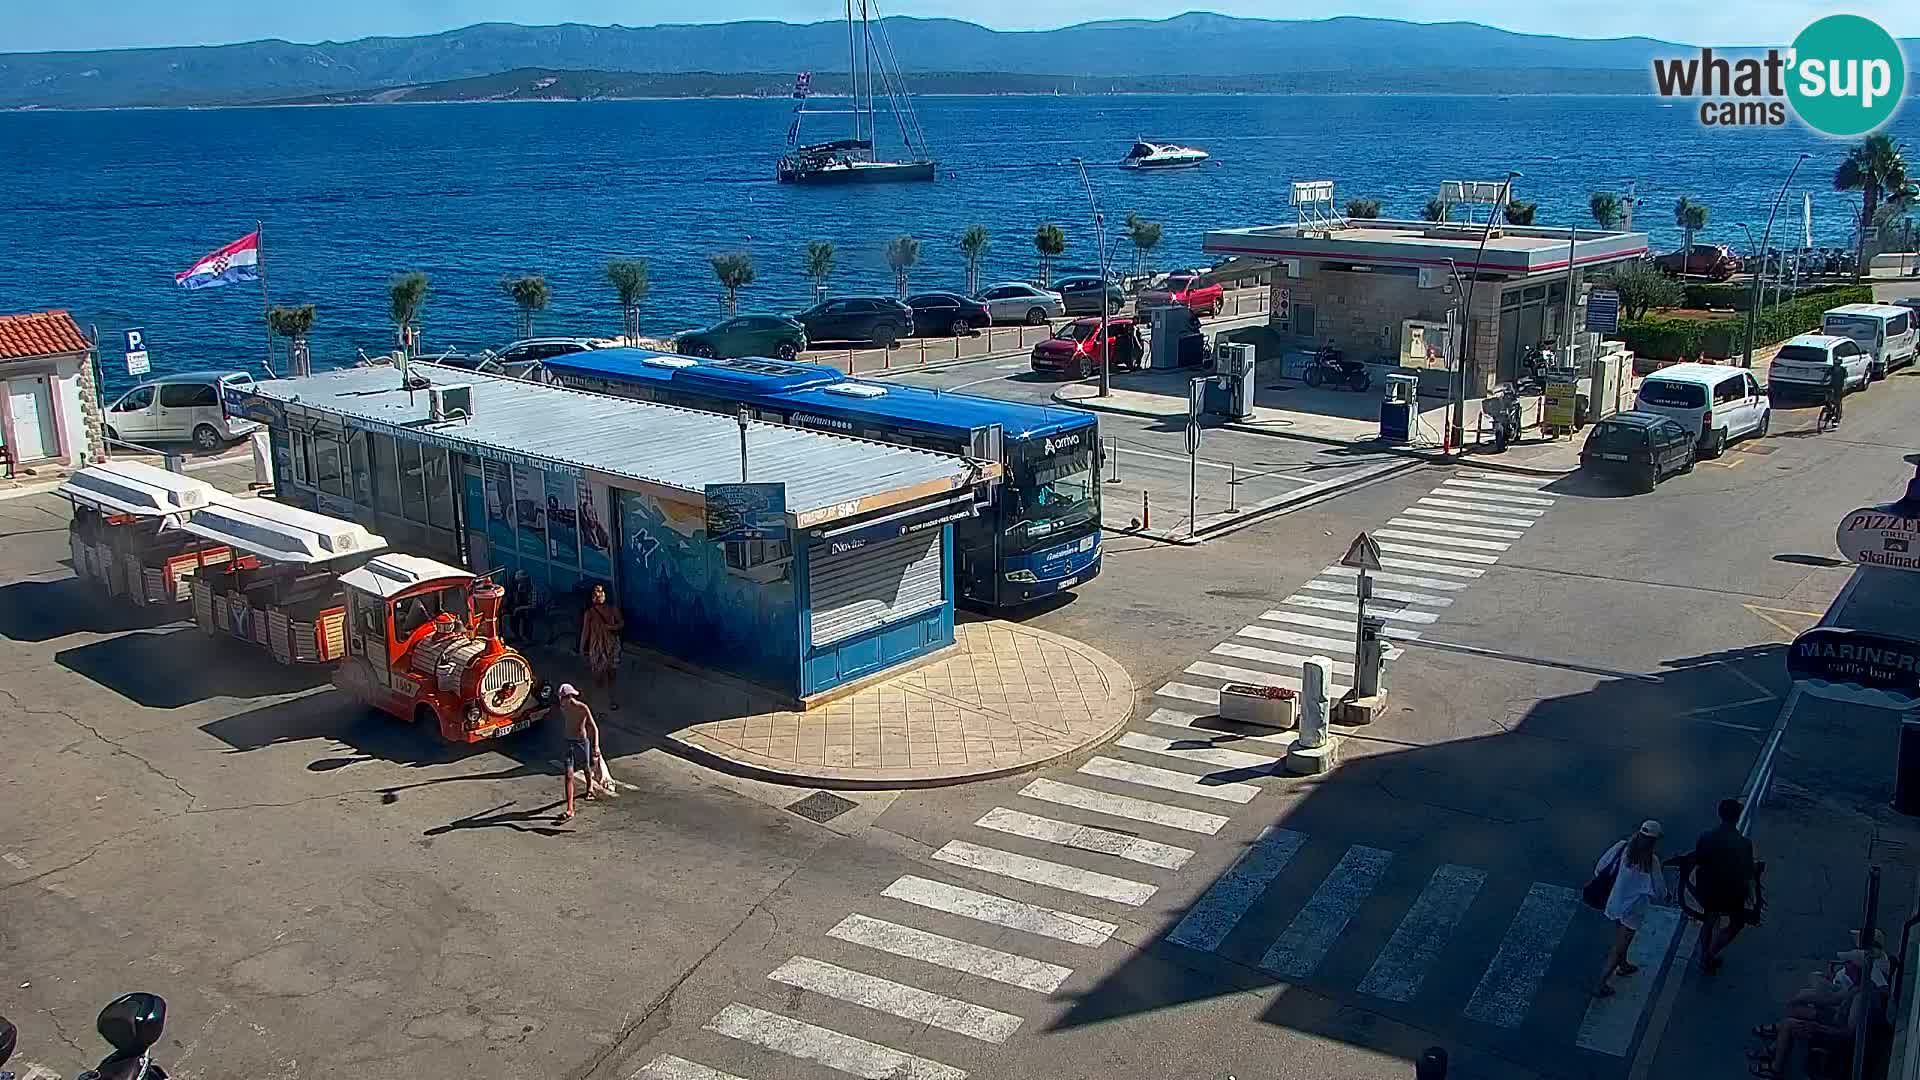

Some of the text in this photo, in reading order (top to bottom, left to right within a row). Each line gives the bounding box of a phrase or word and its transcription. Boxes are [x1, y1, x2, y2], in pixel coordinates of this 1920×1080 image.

[128, 331, 142, 350] P
[1055, 434, 1080, 449] arriva
[494, 449, 525, 465] STATION
[527, 456, 552, 472] TICKET
[554, 463, 581, 477] OFFICE
[1847, 515, 1920, 533] PIZZE
[1869, 665, 1896, 680] bar
